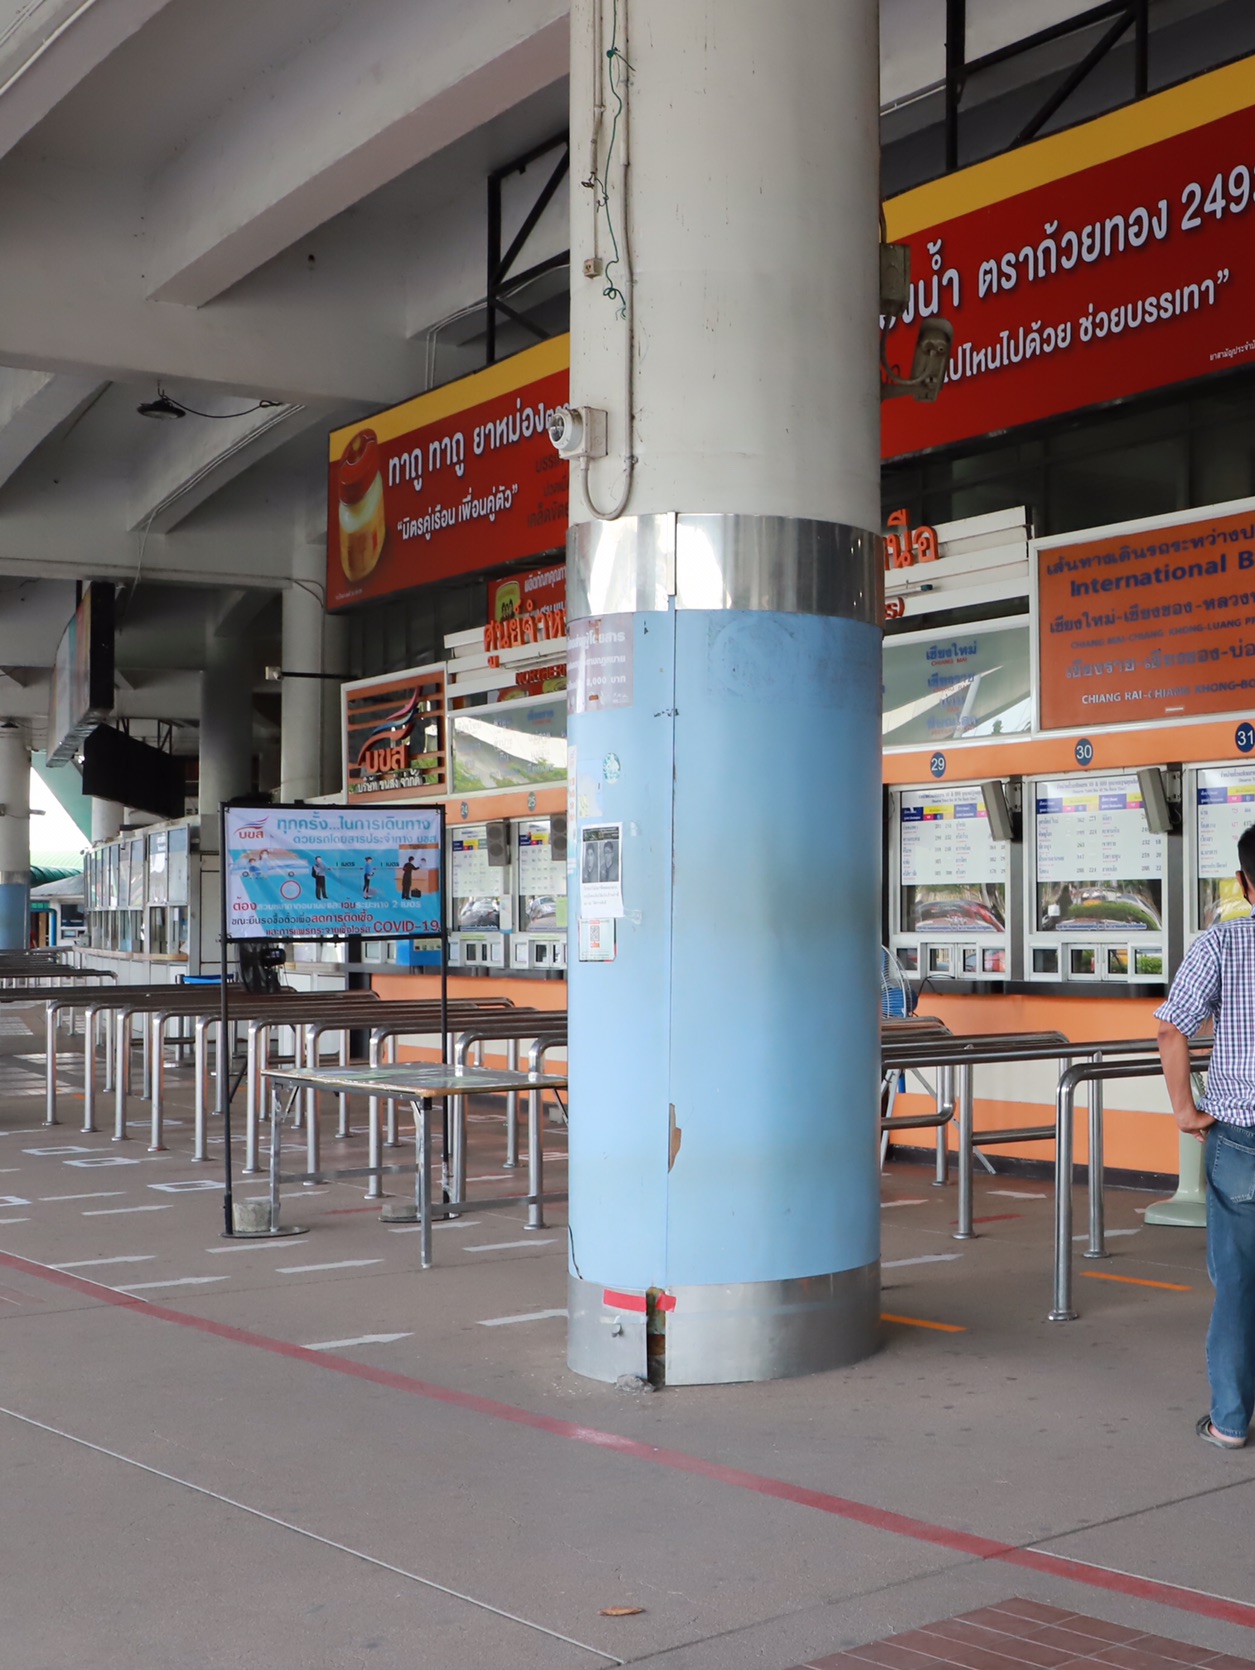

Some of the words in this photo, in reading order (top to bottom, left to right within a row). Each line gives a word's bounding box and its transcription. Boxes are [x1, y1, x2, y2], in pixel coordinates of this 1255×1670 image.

[977, 199, 1168, 299] ตราถ้วยทอง
[389, 448, 422, 491] ทาถู
[428, 431, 464, 476] ทาถู
[883, 509, 939, 571] นือ
[1070, 554, 1226, 597] International
[926, 641, 977, 660] เชียงใหม่
[1082, 692, 1122, 705] CHIANG
[1238, 731, 1255, 745] 31
[1076, 744, 1091, 759] 30
[931, 758, 945, 772] 29
[461, 805, 468, 815] 24
[239, 830, 264, 839] บขส
[373, 920, 440, 933] COVID-19
